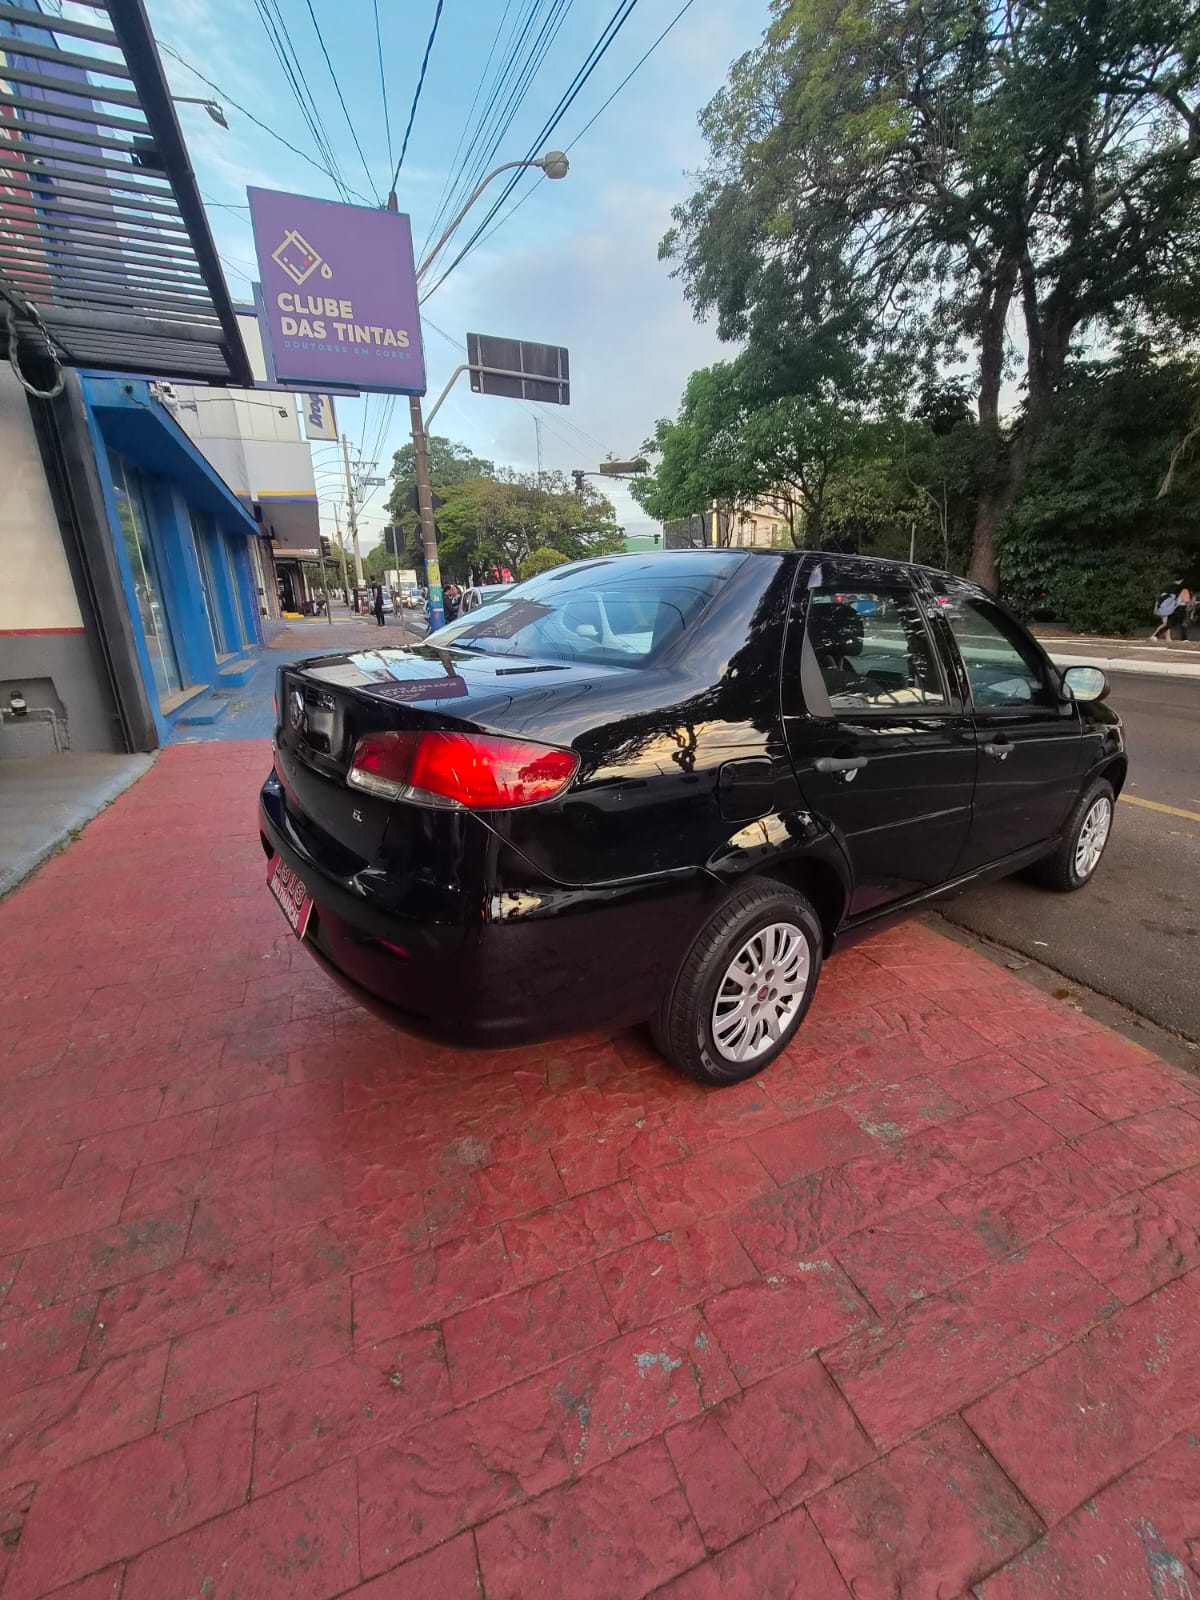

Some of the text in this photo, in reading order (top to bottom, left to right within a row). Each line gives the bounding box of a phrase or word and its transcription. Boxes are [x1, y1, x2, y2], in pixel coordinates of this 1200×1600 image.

[277, 292, 354, 319] CLUBE
[280, 316, 410, 348] DAS TINTAS
[284, 340, 412, 360] DOUTORES EM CORES
